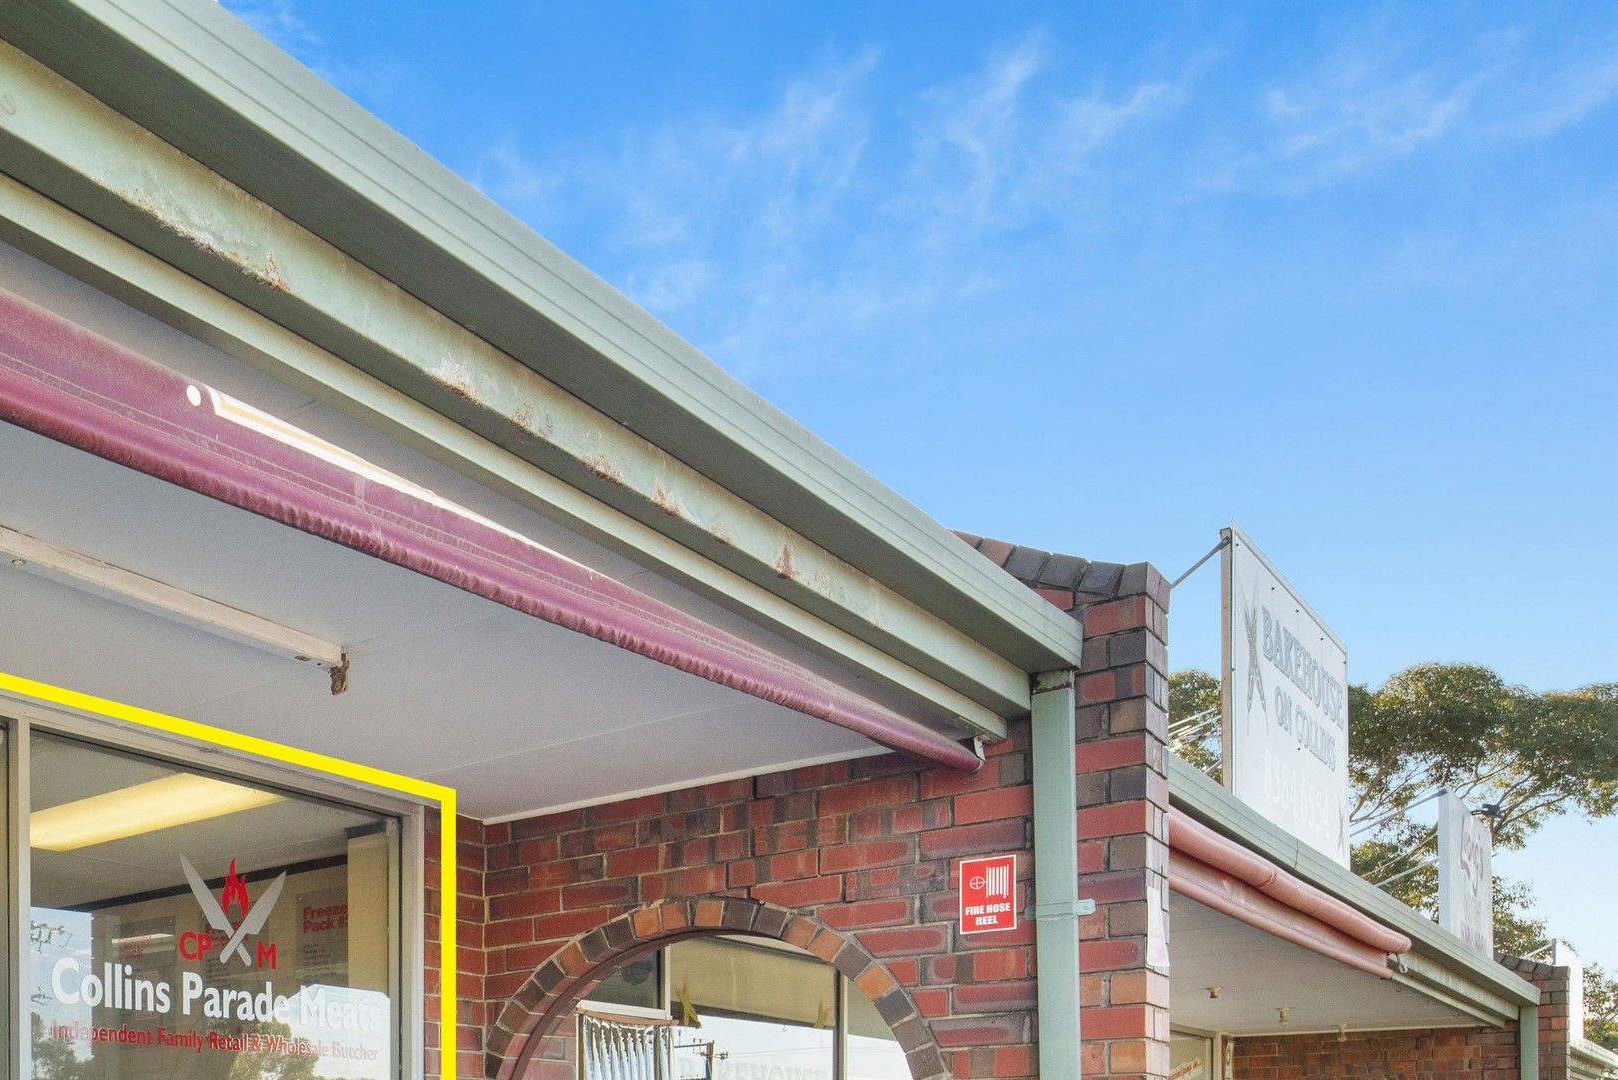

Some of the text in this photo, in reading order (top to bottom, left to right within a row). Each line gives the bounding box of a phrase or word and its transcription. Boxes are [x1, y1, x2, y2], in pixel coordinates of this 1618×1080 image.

[1262, 605, 1343, 731] BAKEHOUSE
[1275, 686, 1335, 772] ON COLLINS
[302, 904, 348, 919] Freeze
[302, 918, 335, 933] Pack
[965, 902, 1010, 916] FIRE HOSE
[975, 916, 998, 926] REEL
[178, 931, 213, 961] CP
[257, 941, 277, 970] M
[51, 957, 382, 1033] Collins Parade Meats
[51, 1019, 381, 1062] Independent Family Retail & Wholesale Butcher
